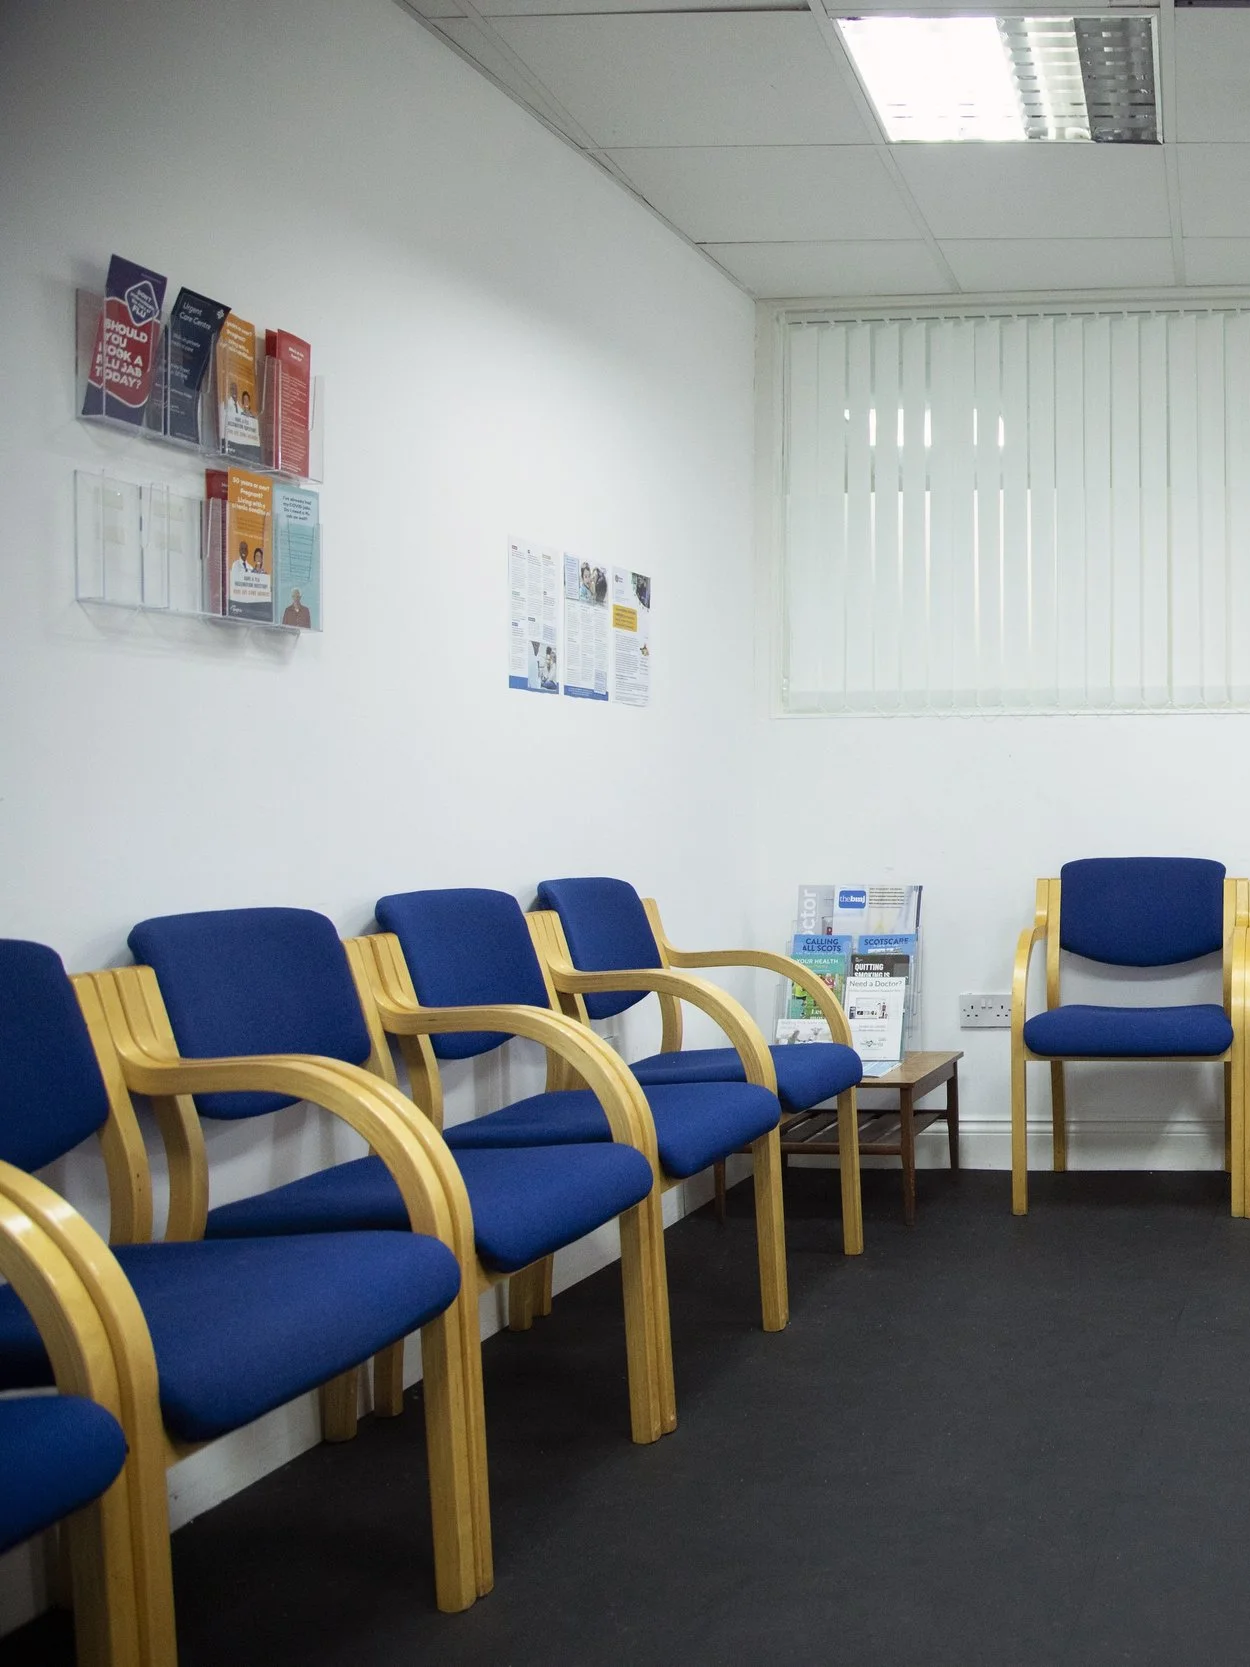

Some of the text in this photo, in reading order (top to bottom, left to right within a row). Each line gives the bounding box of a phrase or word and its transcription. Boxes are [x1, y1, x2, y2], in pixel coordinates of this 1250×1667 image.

[132, 304, 147, 318] FLU
[182, 302, 202, 316] Urgent
[180, 311, 193, 322] Care
[193, 317, 212, 330] Centre
[104, 318, 148, 343] SHOULD
[104, 331, 128, 348] YOU
[134, 355, 143, 367] A
[95, 365, 142, 389] TODAY?
[121, 362, 142, 378] JAB
[232, 476, 240, 484] 50
[240, 480, 253, 488] years
[259, 484, 270, 492] over?
[240, 488, 263, 498] Pregnant?
[864, 937, 909, 946] SCOTSCARE
[854, 963, 884, 971] QUITTING
